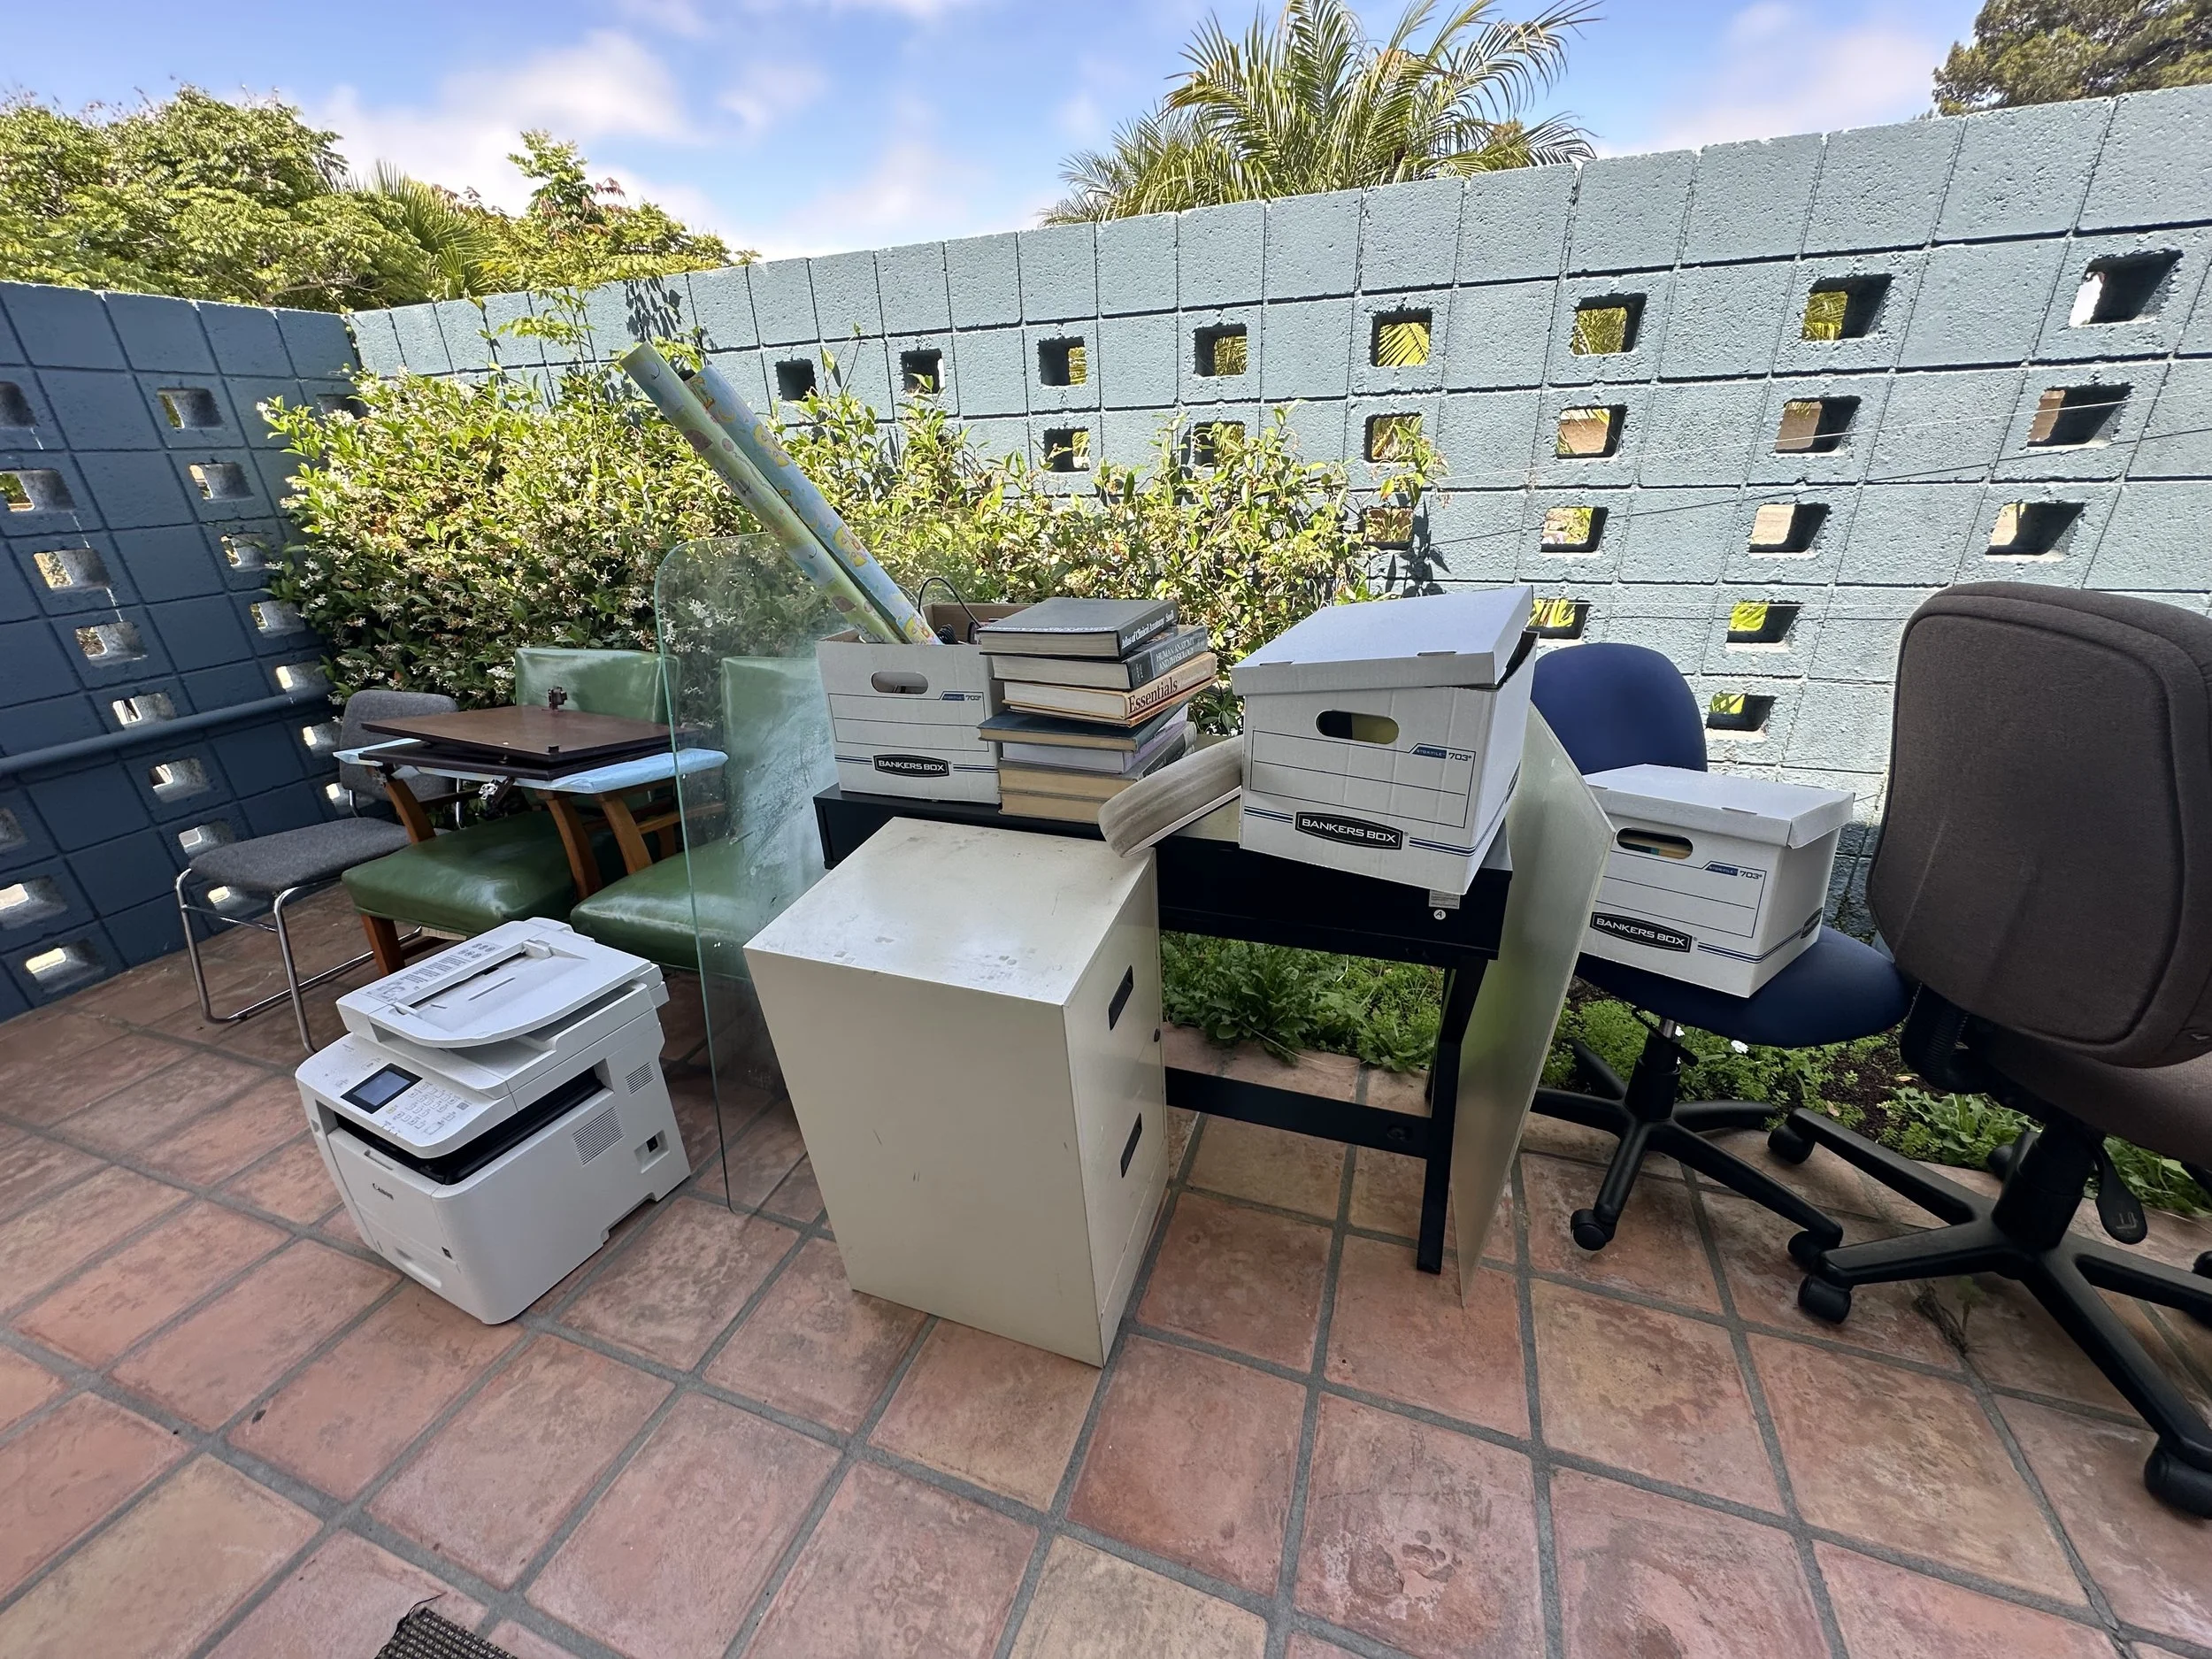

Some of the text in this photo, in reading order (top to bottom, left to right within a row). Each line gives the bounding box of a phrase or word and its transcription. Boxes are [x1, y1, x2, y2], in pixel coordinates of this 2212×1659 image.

[1121, 635, 1133, 649] Atlas
[1135, 624, 1149, 640] Clinical
[1128, 677, 1178, 714] Essentials
[879, 760, 923, 770] BANKERS
[1302, 818, 1396, 843] BANKERS BOX
[1596, 918, 1686, 947] BANKERS BOX
